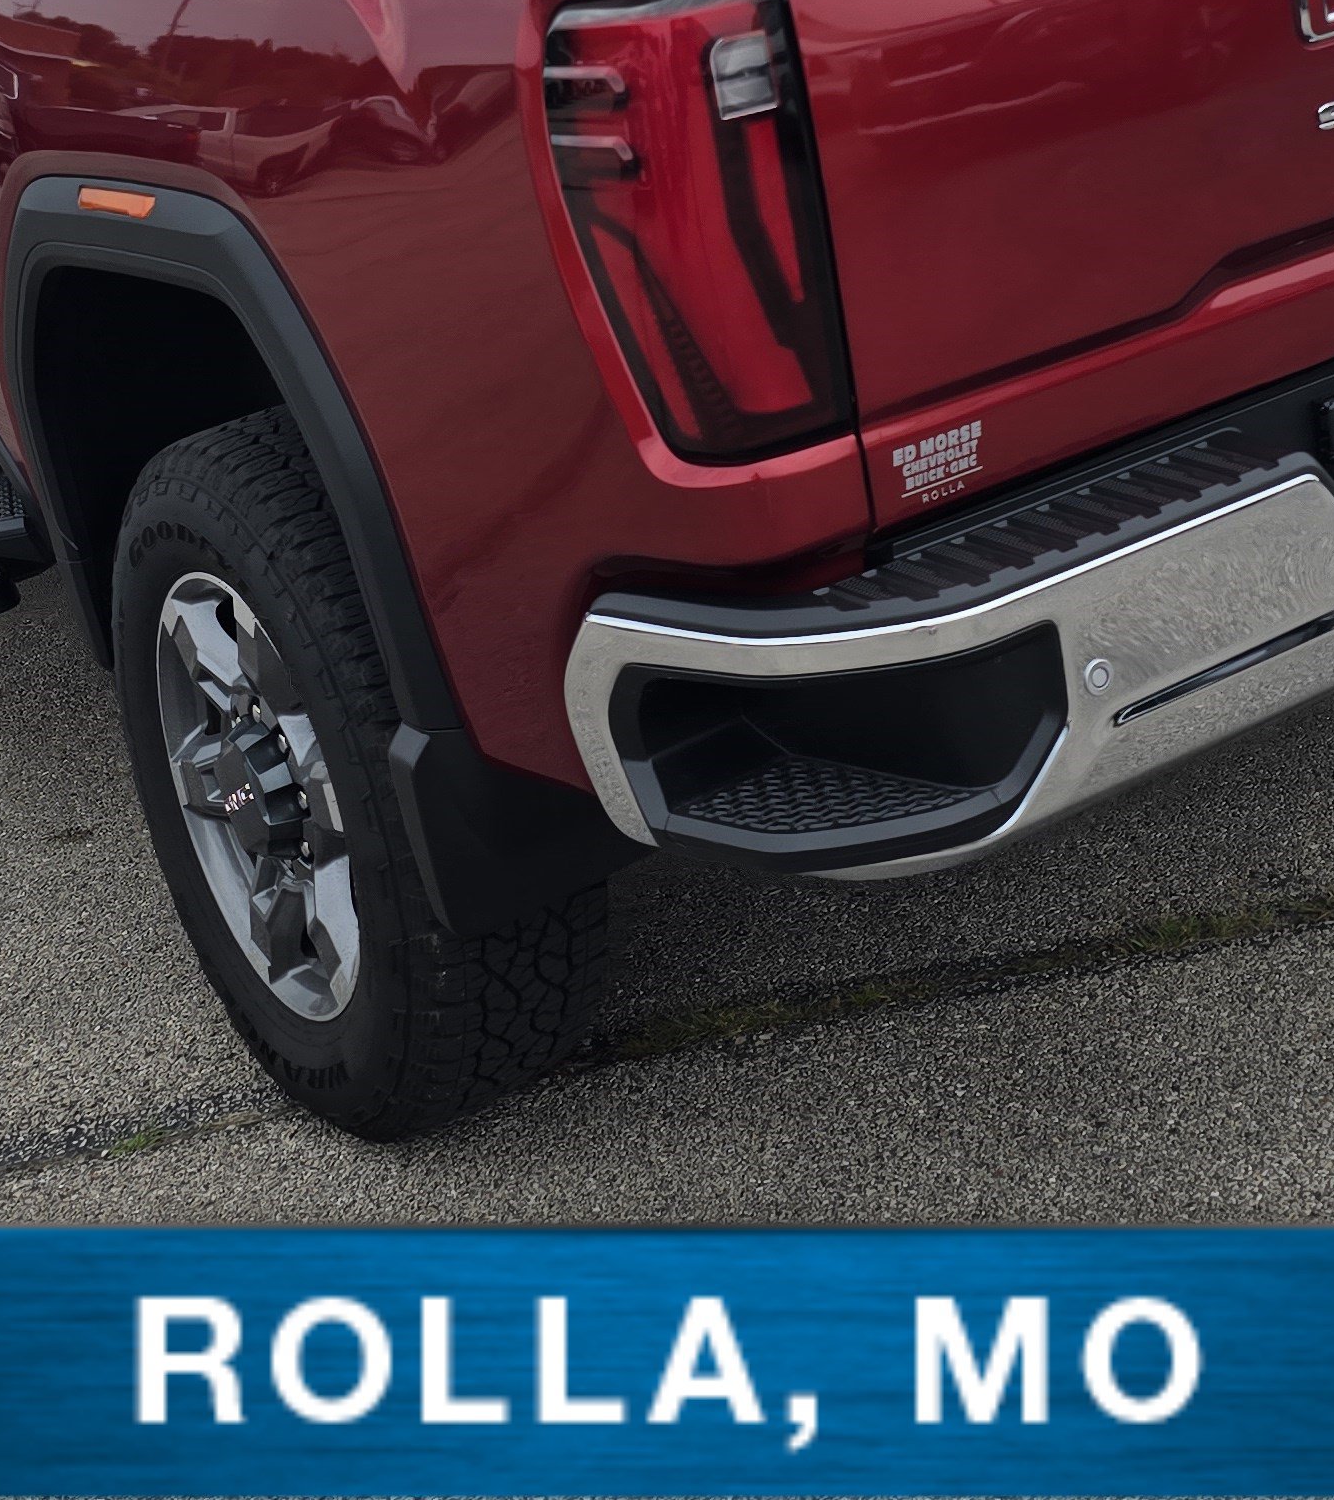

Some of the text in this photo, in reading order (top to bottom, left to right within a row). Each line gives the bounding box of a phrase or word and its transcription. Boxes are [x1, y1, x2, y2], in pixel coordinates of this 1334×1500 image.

[892, 420, 982, 467] ED MORSE
[902, 438, 978, 477] CHEVROLET
[922, 480, 965, 504] ROLLA
